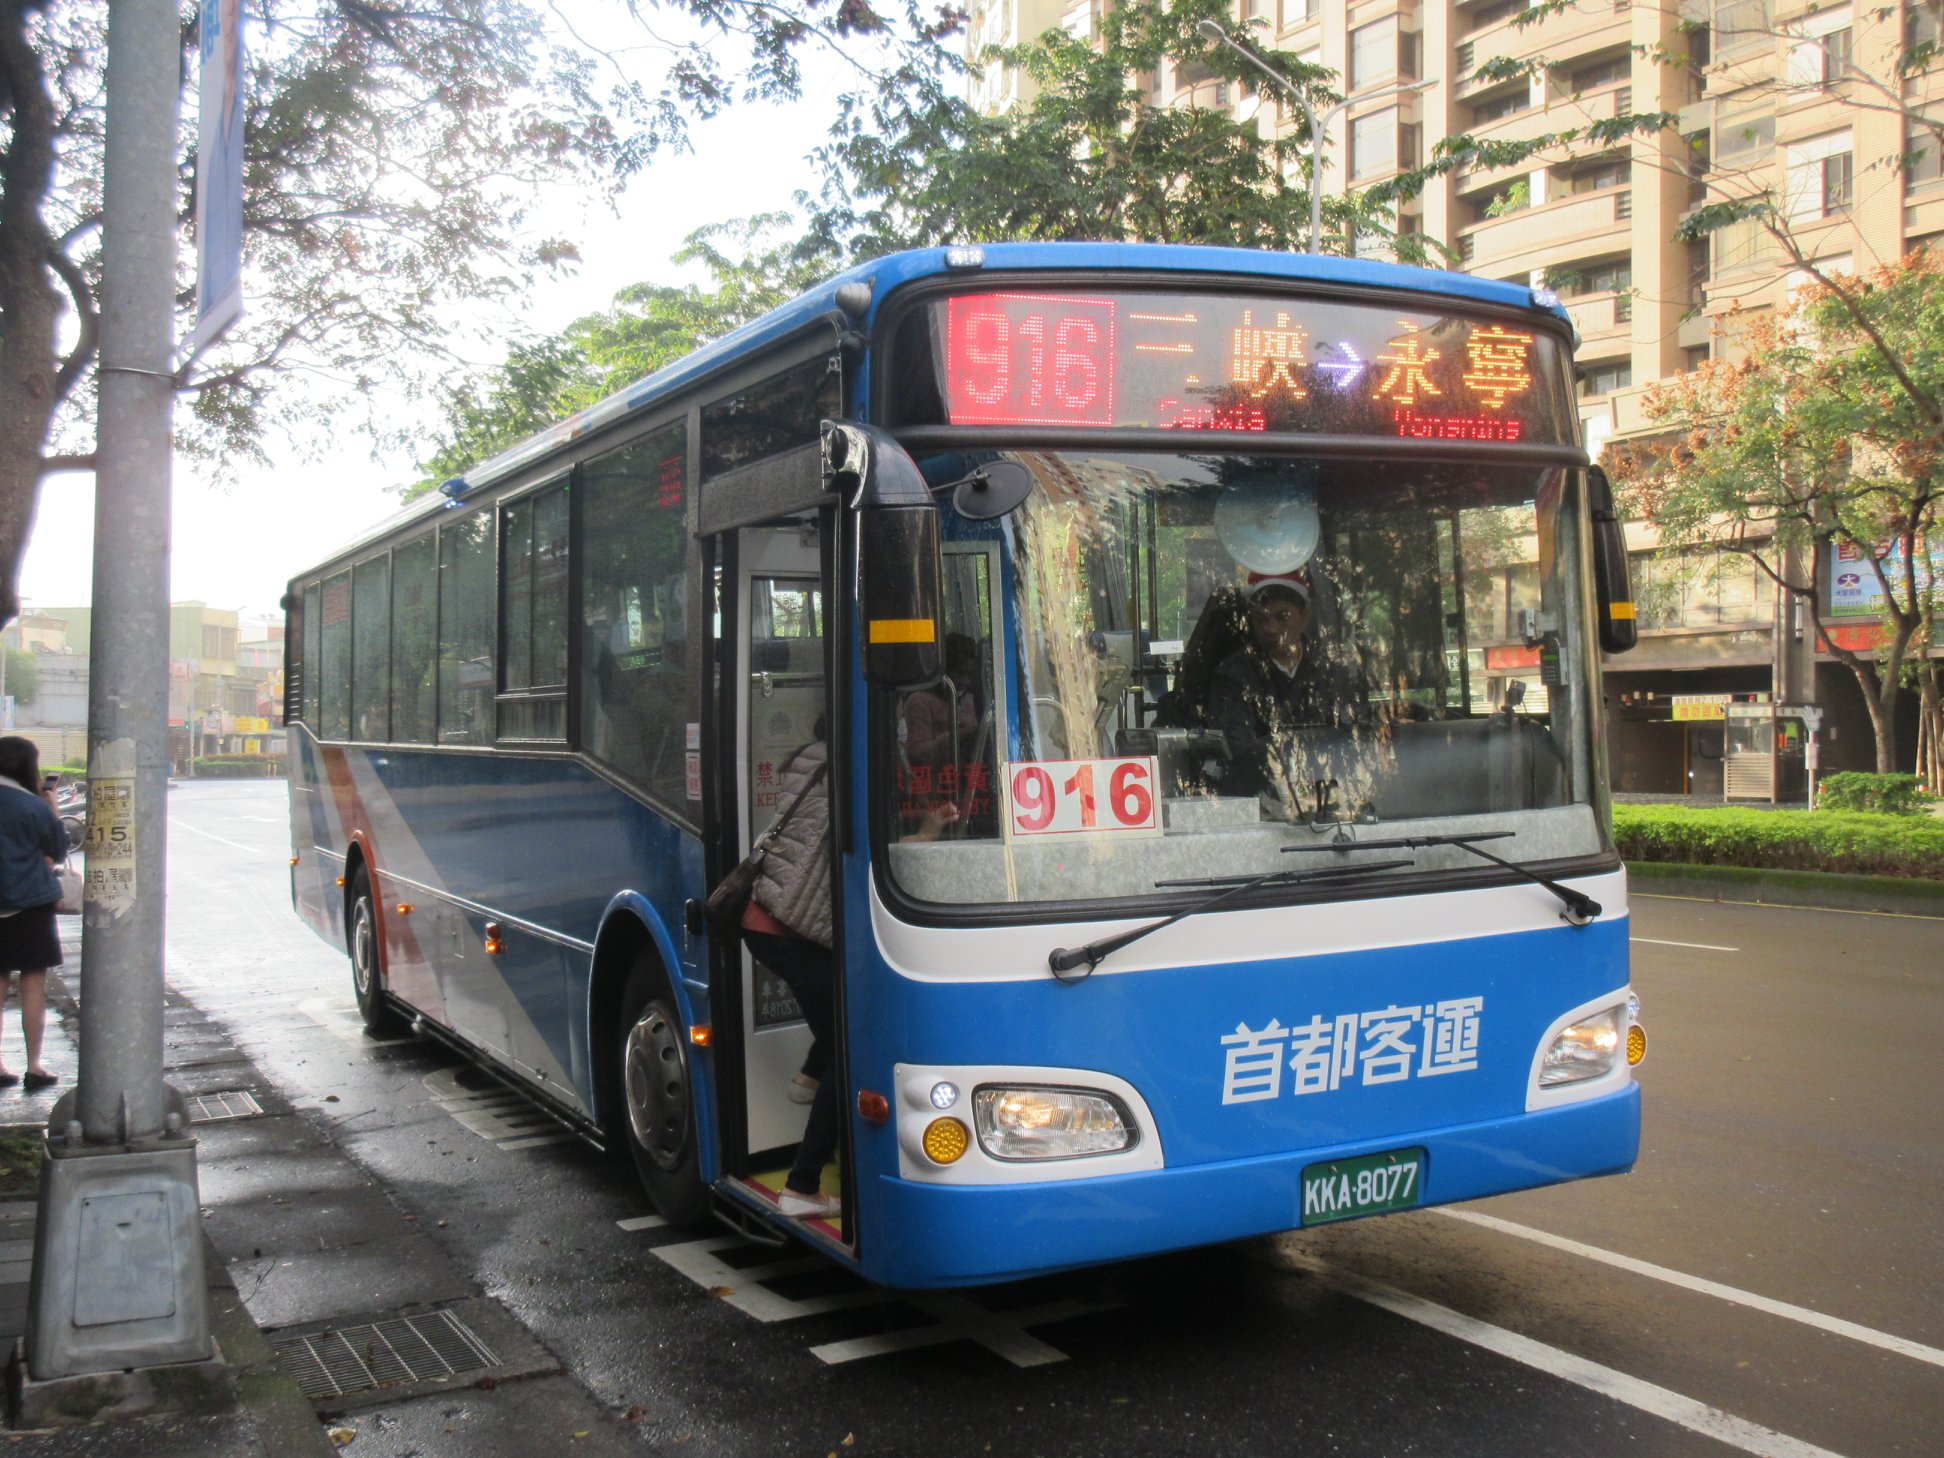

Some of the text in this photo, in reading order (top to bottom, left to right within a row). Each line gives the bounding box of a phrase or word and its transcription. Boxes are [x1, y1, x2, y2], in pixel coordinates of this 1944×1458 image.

[964, 312, 1098, 410] 916
[1129, 309, 1534, 409] 三峽 永寧
[1159, 399, 1521, 440] Sanxia Yongning
[1012, 761, 1152, 831] 916
[1220, 995, 1484, 1105] 首都客運
